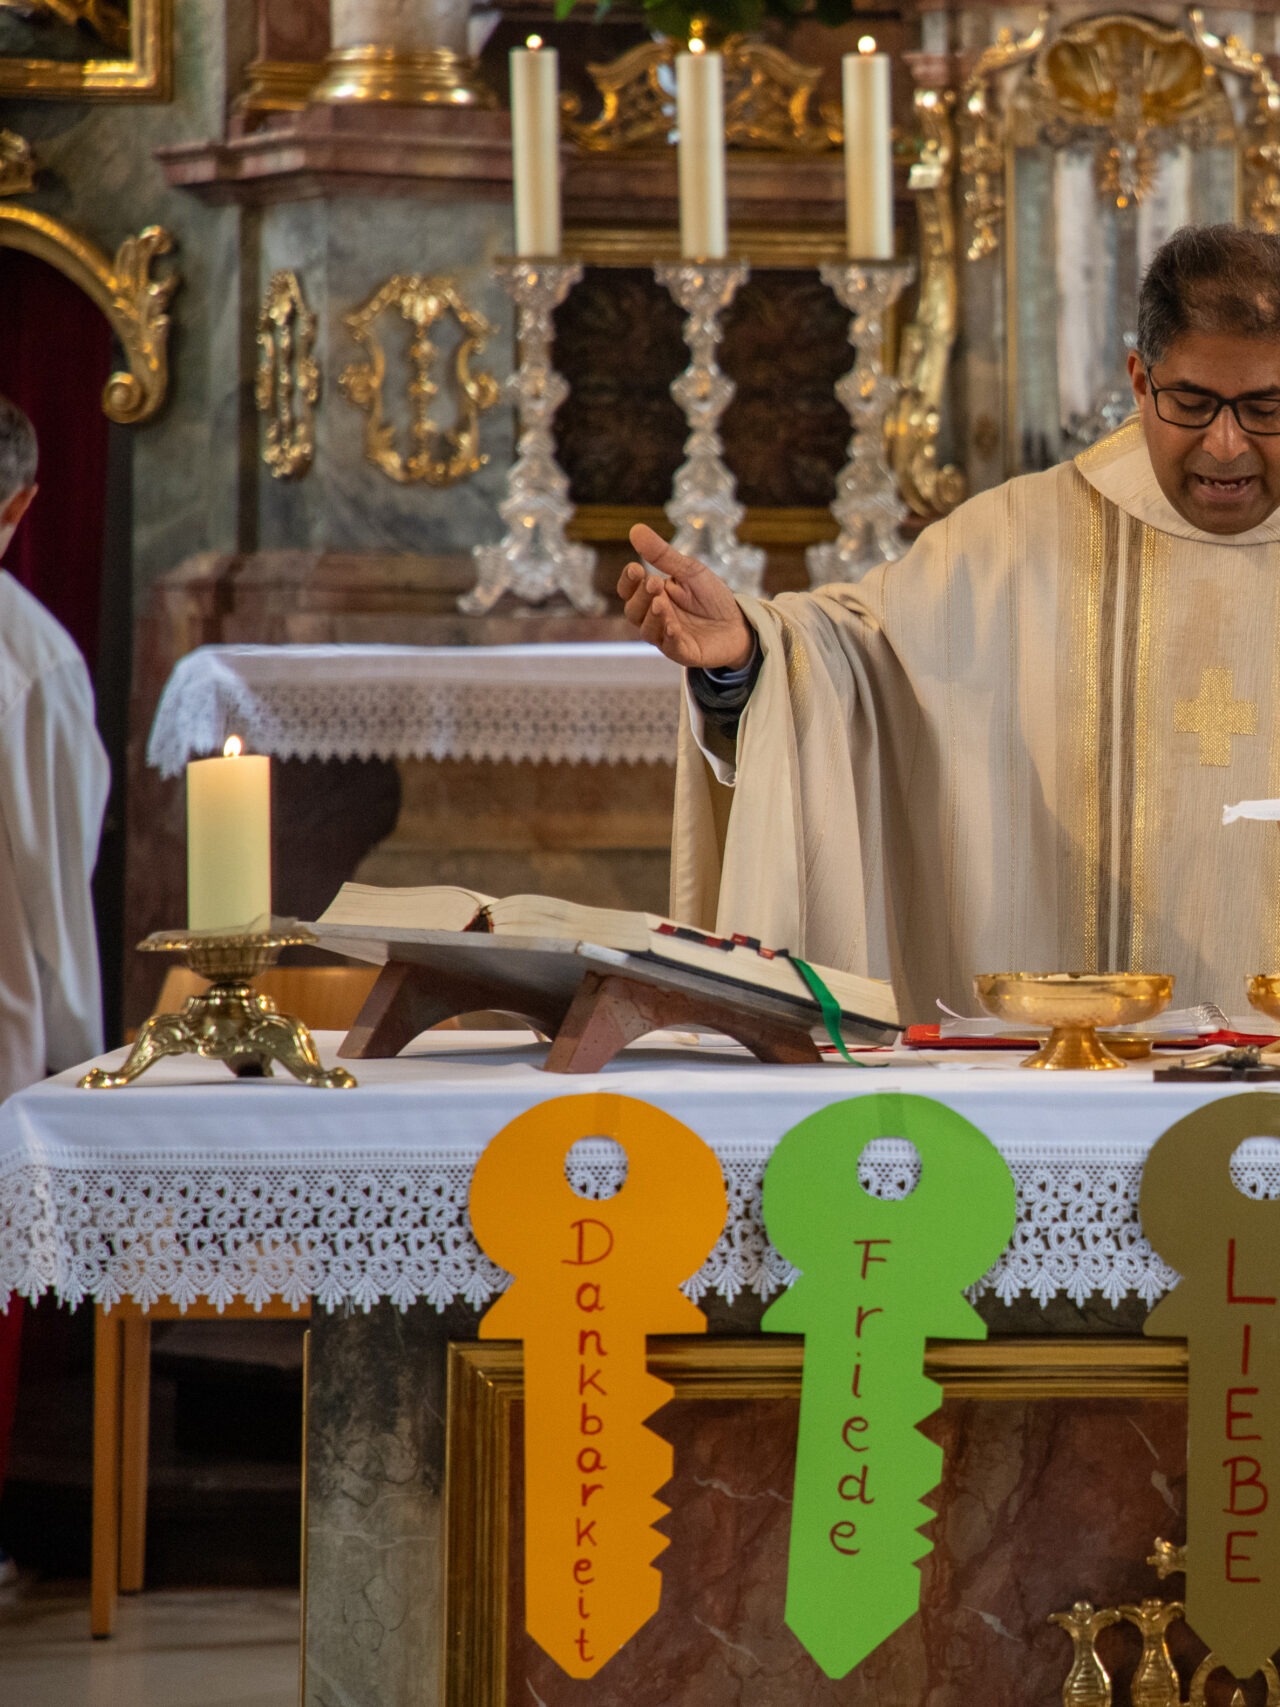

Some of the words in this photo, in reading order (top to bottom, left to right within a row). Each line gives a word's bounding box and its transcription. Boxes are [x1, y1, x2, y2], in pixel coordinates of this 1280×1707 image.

[561, 1218, 614, 1663] Dankbarkeit
[828, 1239, 892, 1556] Friede
[1222, 1238, 1277, 1583] LIEBE
